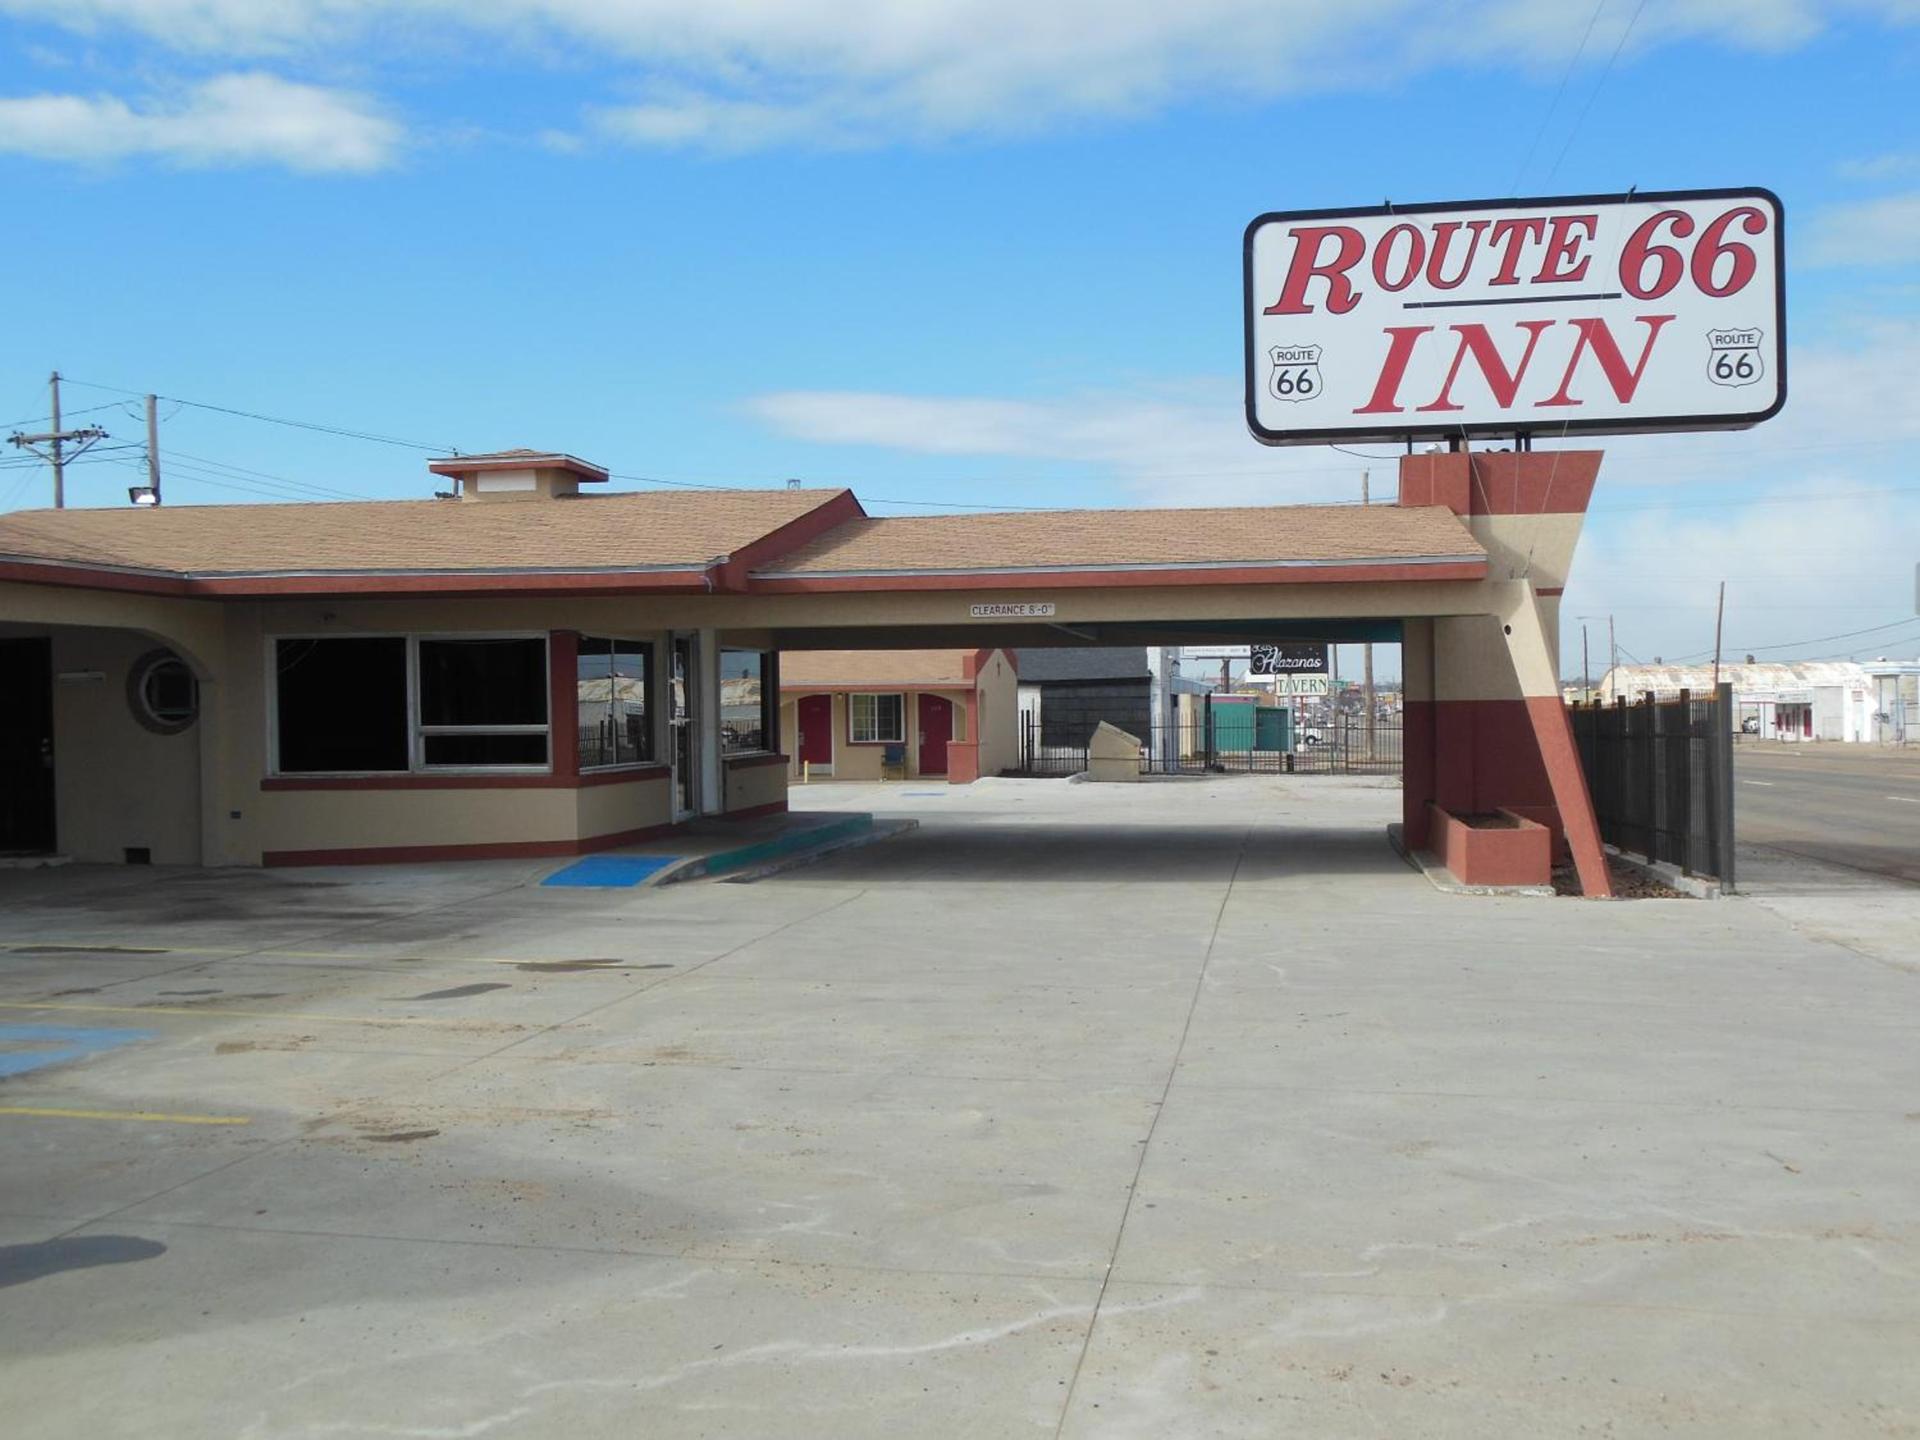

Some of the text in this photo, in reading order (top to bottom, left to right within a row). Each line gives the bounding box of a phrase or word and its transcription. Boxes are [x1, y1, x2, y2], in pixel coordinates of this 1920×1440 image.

[1263, 206, 1768, 316] ROUTE 66
[1715, 332, 1756, 346] ROUTE
[1276, 349, 1314, 363] ROUTE
[1352, 314, 1677, 414] INN
[1715, 353, 1754, 380] 66
[1276, 369, 1314, 395] 66
[972, 604, 1025, 615] CLEARANCE
